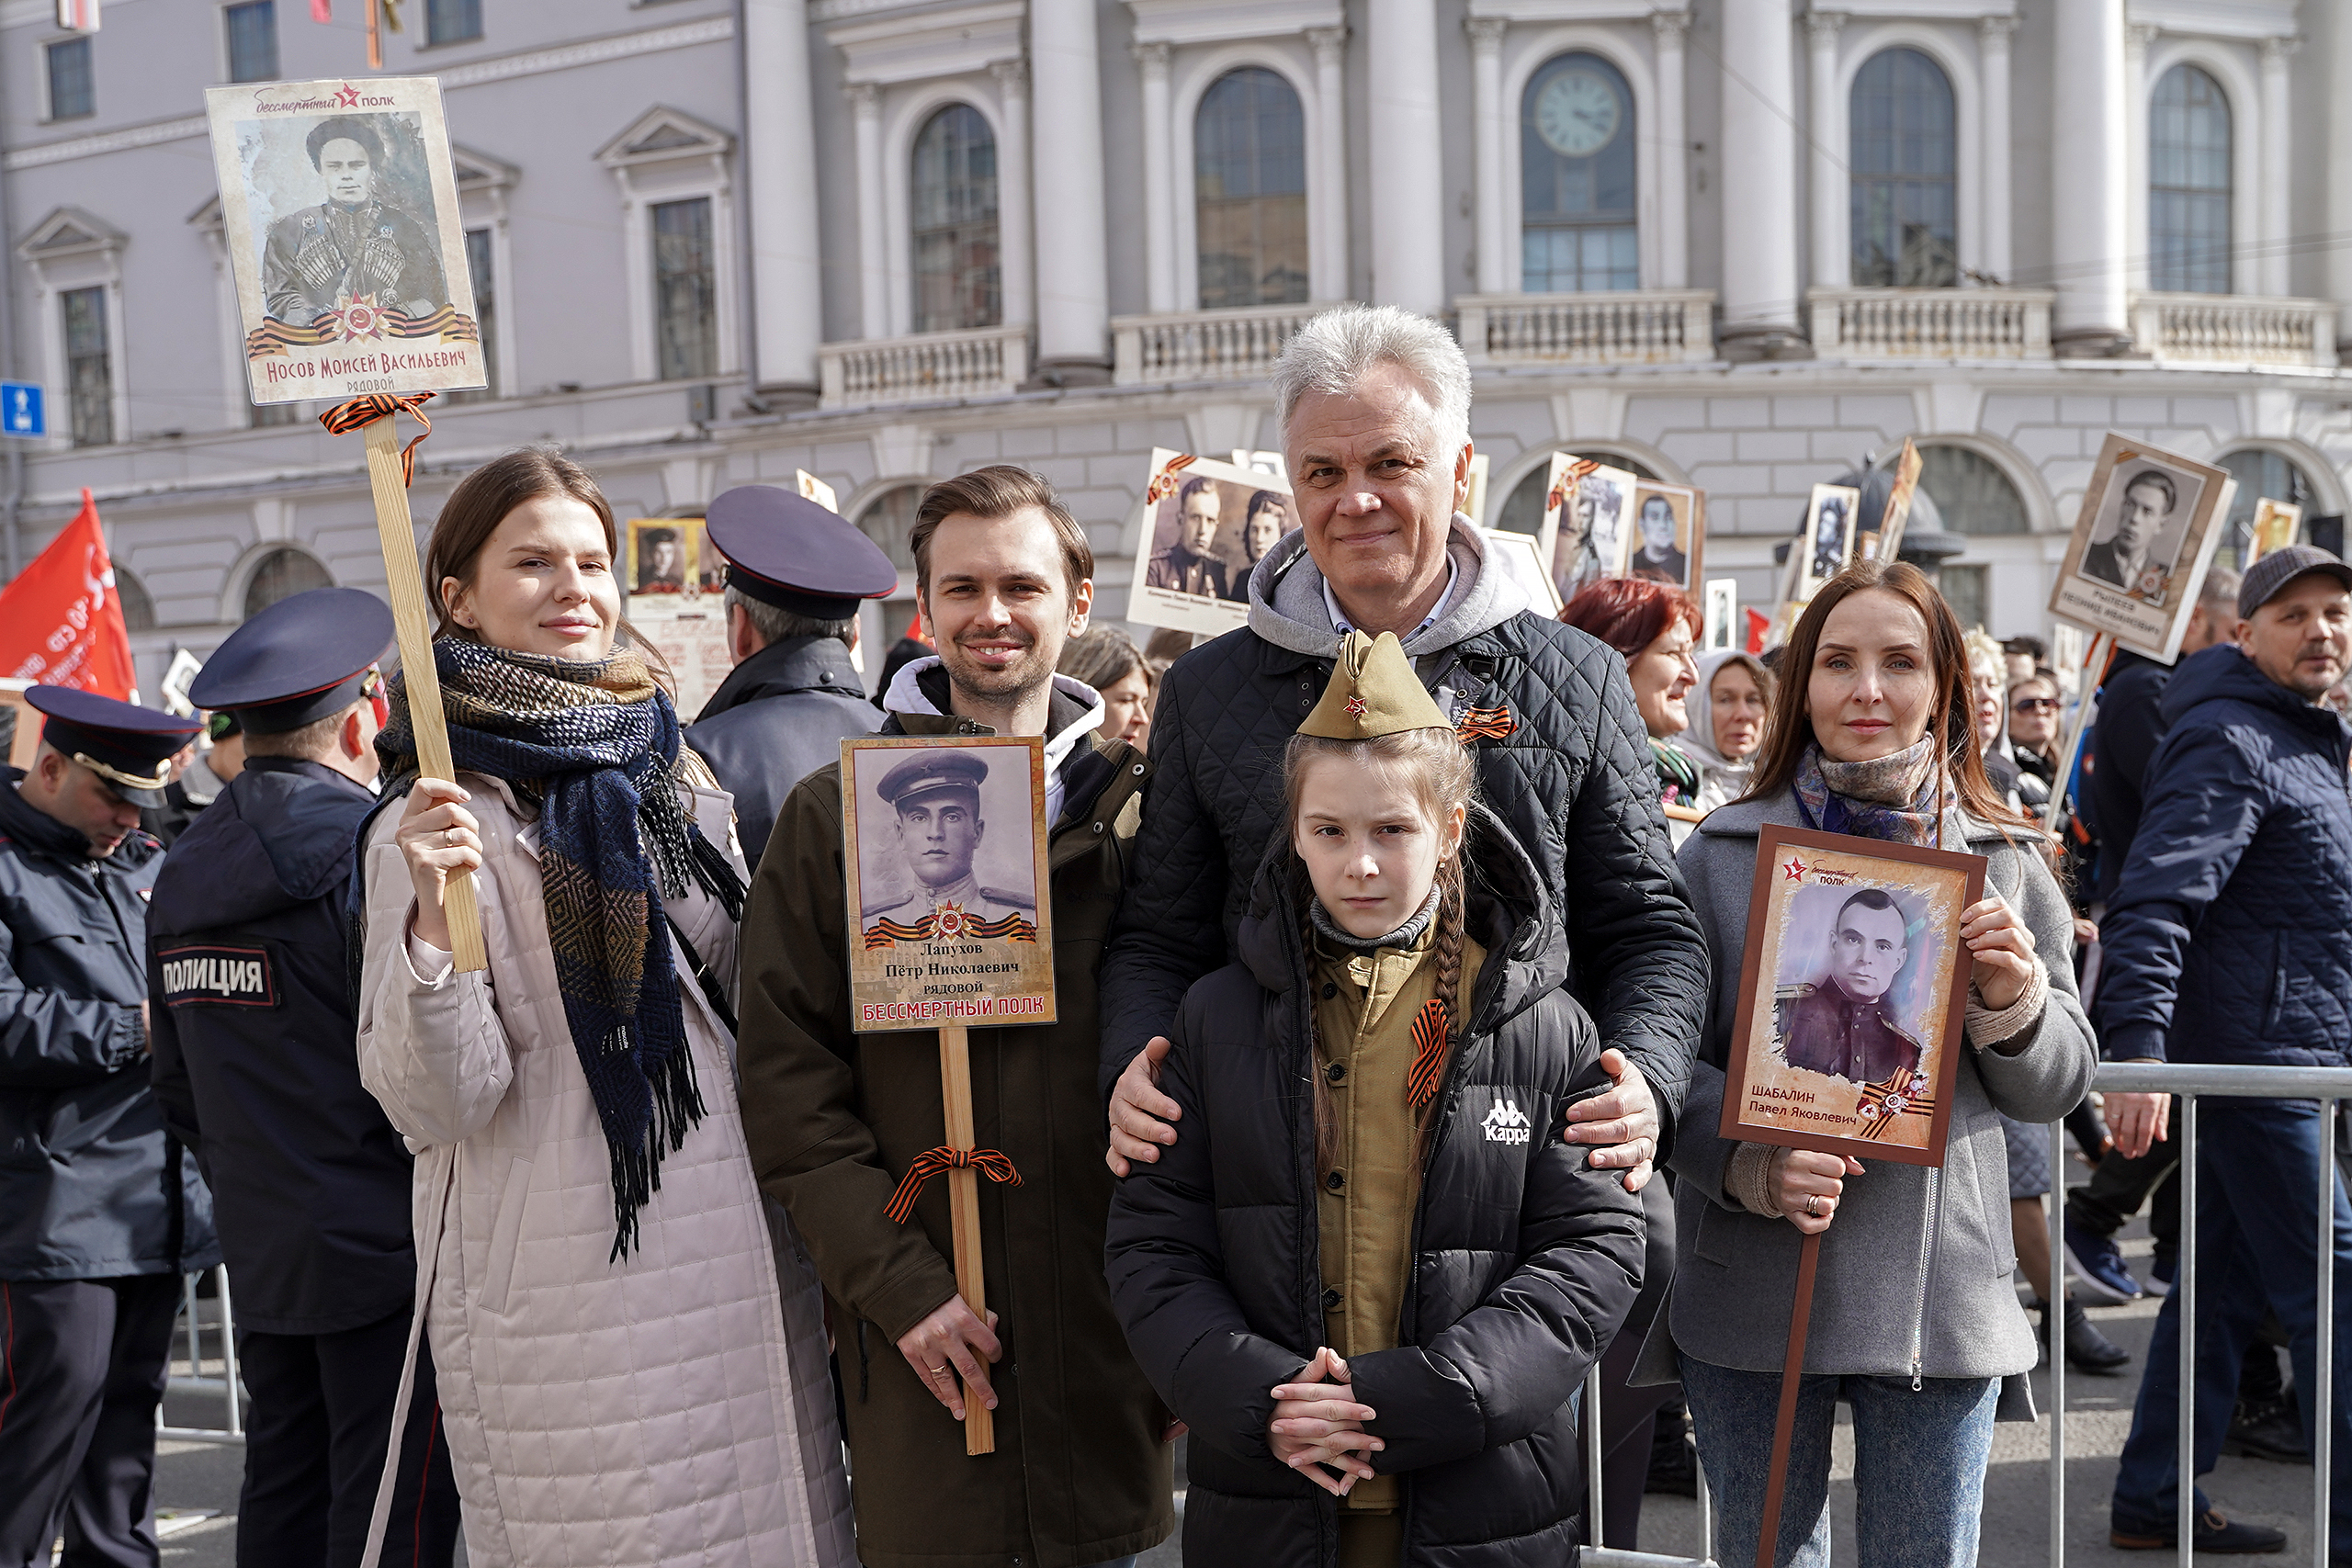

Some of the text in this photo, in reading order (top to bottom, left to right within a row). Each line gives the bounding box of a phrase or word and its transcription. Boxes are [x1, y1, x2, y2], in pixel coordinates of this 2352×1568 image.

[920, 942, 983, 958] Лапухов
[163, 957, 264, 997] ПОЛИЦИЯ
[885, 962, 1020, 980] Пётр Николаевич
[863, 996, 1045, 1021] БЕССМЕРТНЫЙ ПОЛК
[1751, 1085, 1815, 1104] ШАБАЛИН
[1749, 1100, 1857, 1125] Павел Яковлевич
[1485, 1124, 1531, 1145] Kappa
